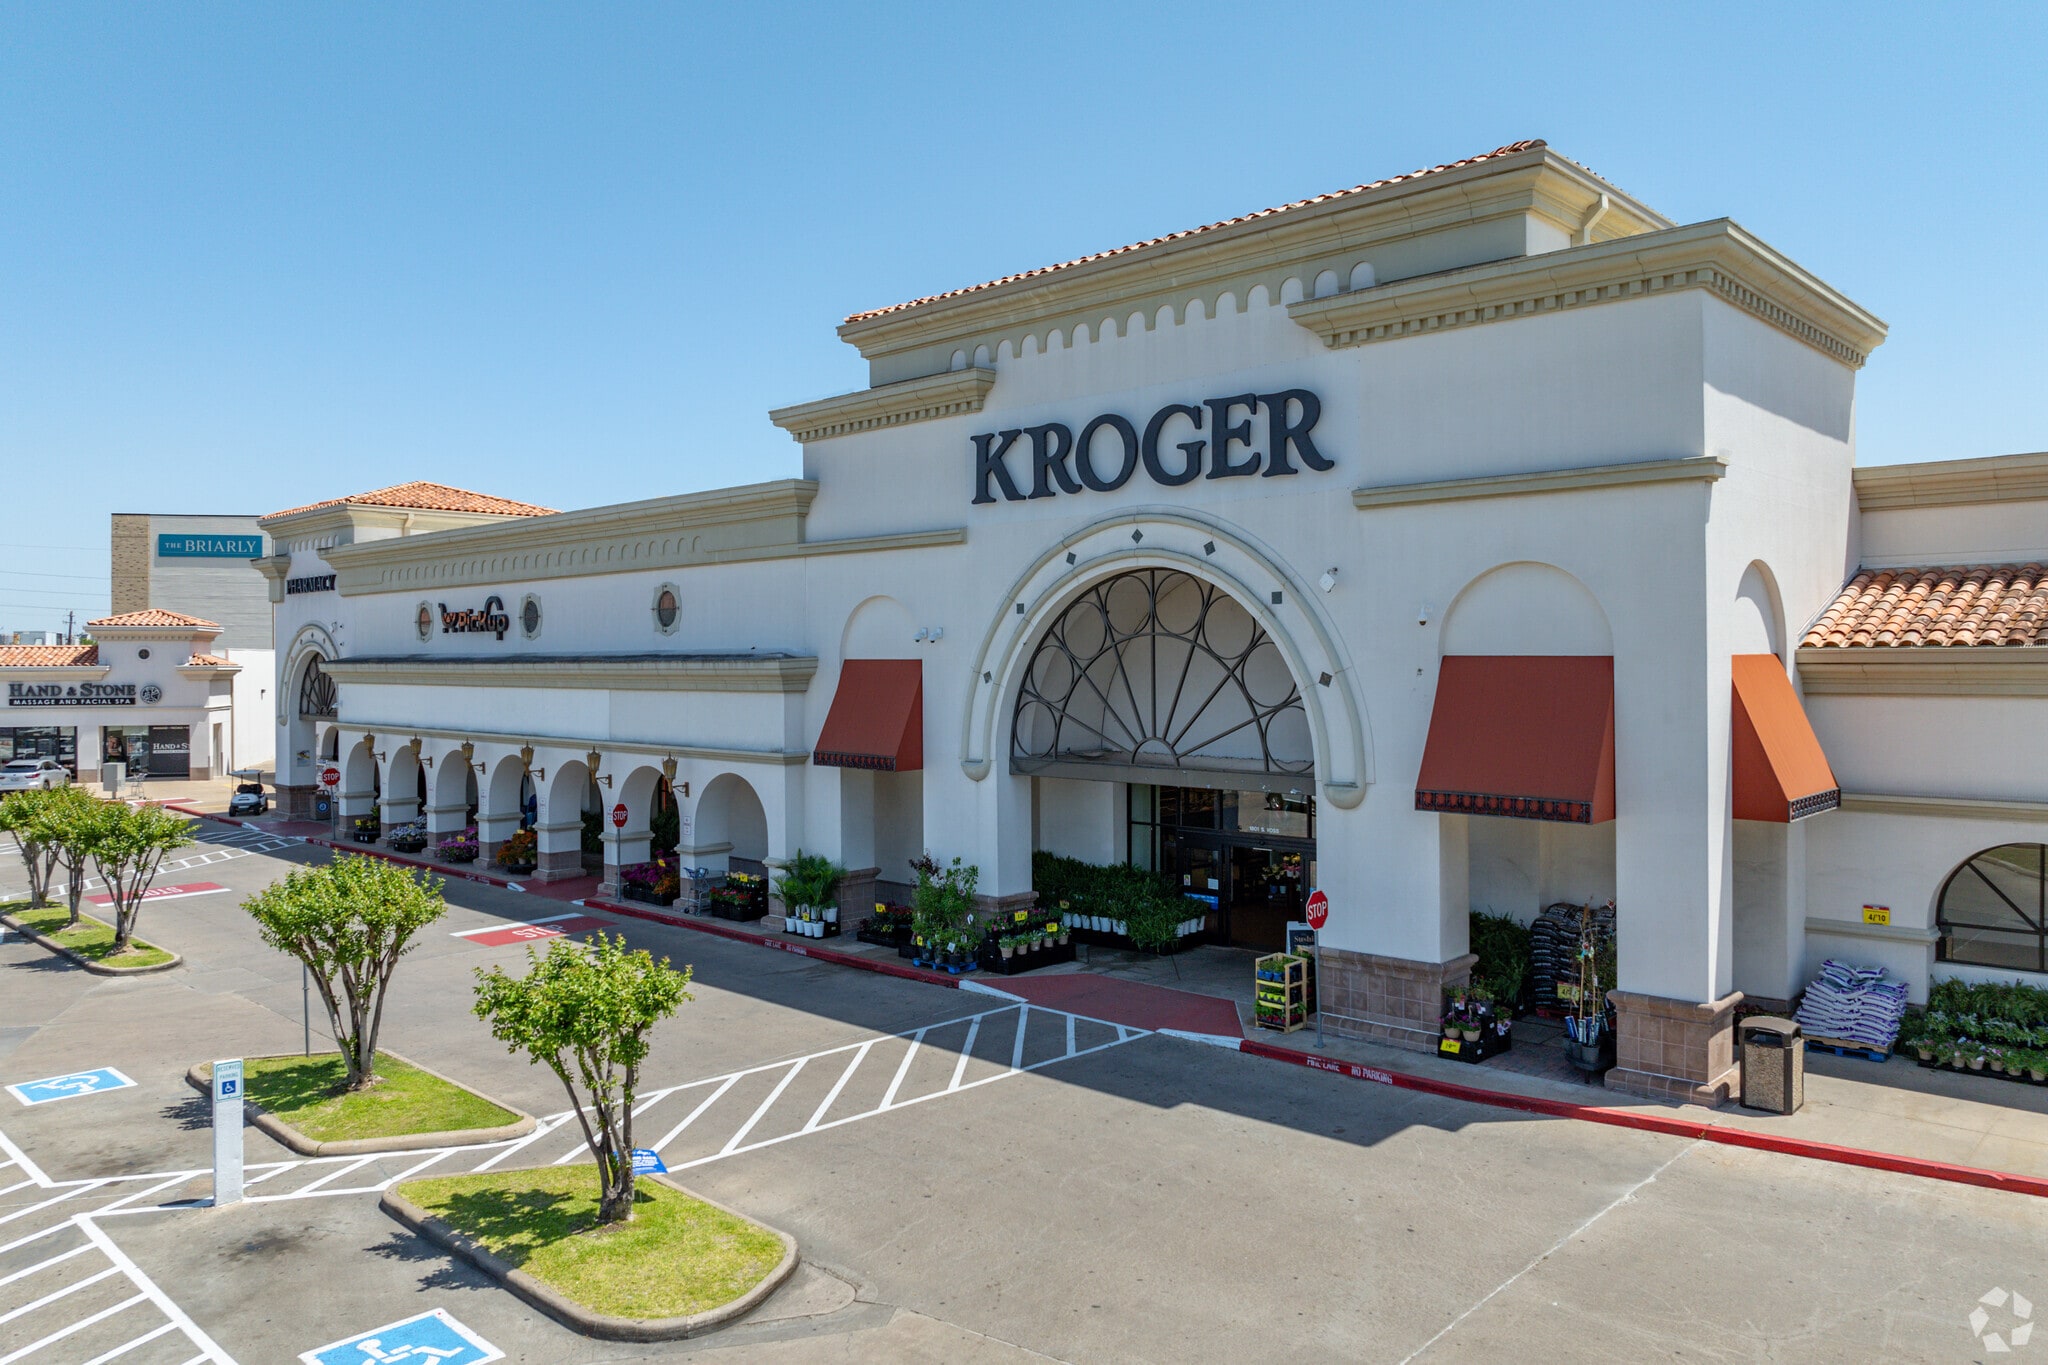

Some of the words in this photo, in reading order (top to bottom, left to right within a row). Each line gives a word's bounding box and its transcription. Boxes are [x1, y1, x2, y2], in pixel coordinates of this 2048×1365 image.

[970, 388, 1335, 505] KROGER
[185, 539, 257, 553] BRIARLY
[286, 574, 337, 595] PHARMACY
[8, 683, 63, 697] HAND
[66, 685, 77, 697] &
[80, 682, 137, 697] STONE
[323, 773, 340, 781] STOP
[613, 810, 628, 821] STOP
[1308, 901, 1327, 920] STOP
[512, 924, 567, 938] STOP
[1293, 935, 1314, 943] Sushi
[1351, 1065, 1361, 1077] NO
[1362, 1067, 1393, 1085] PARKING
